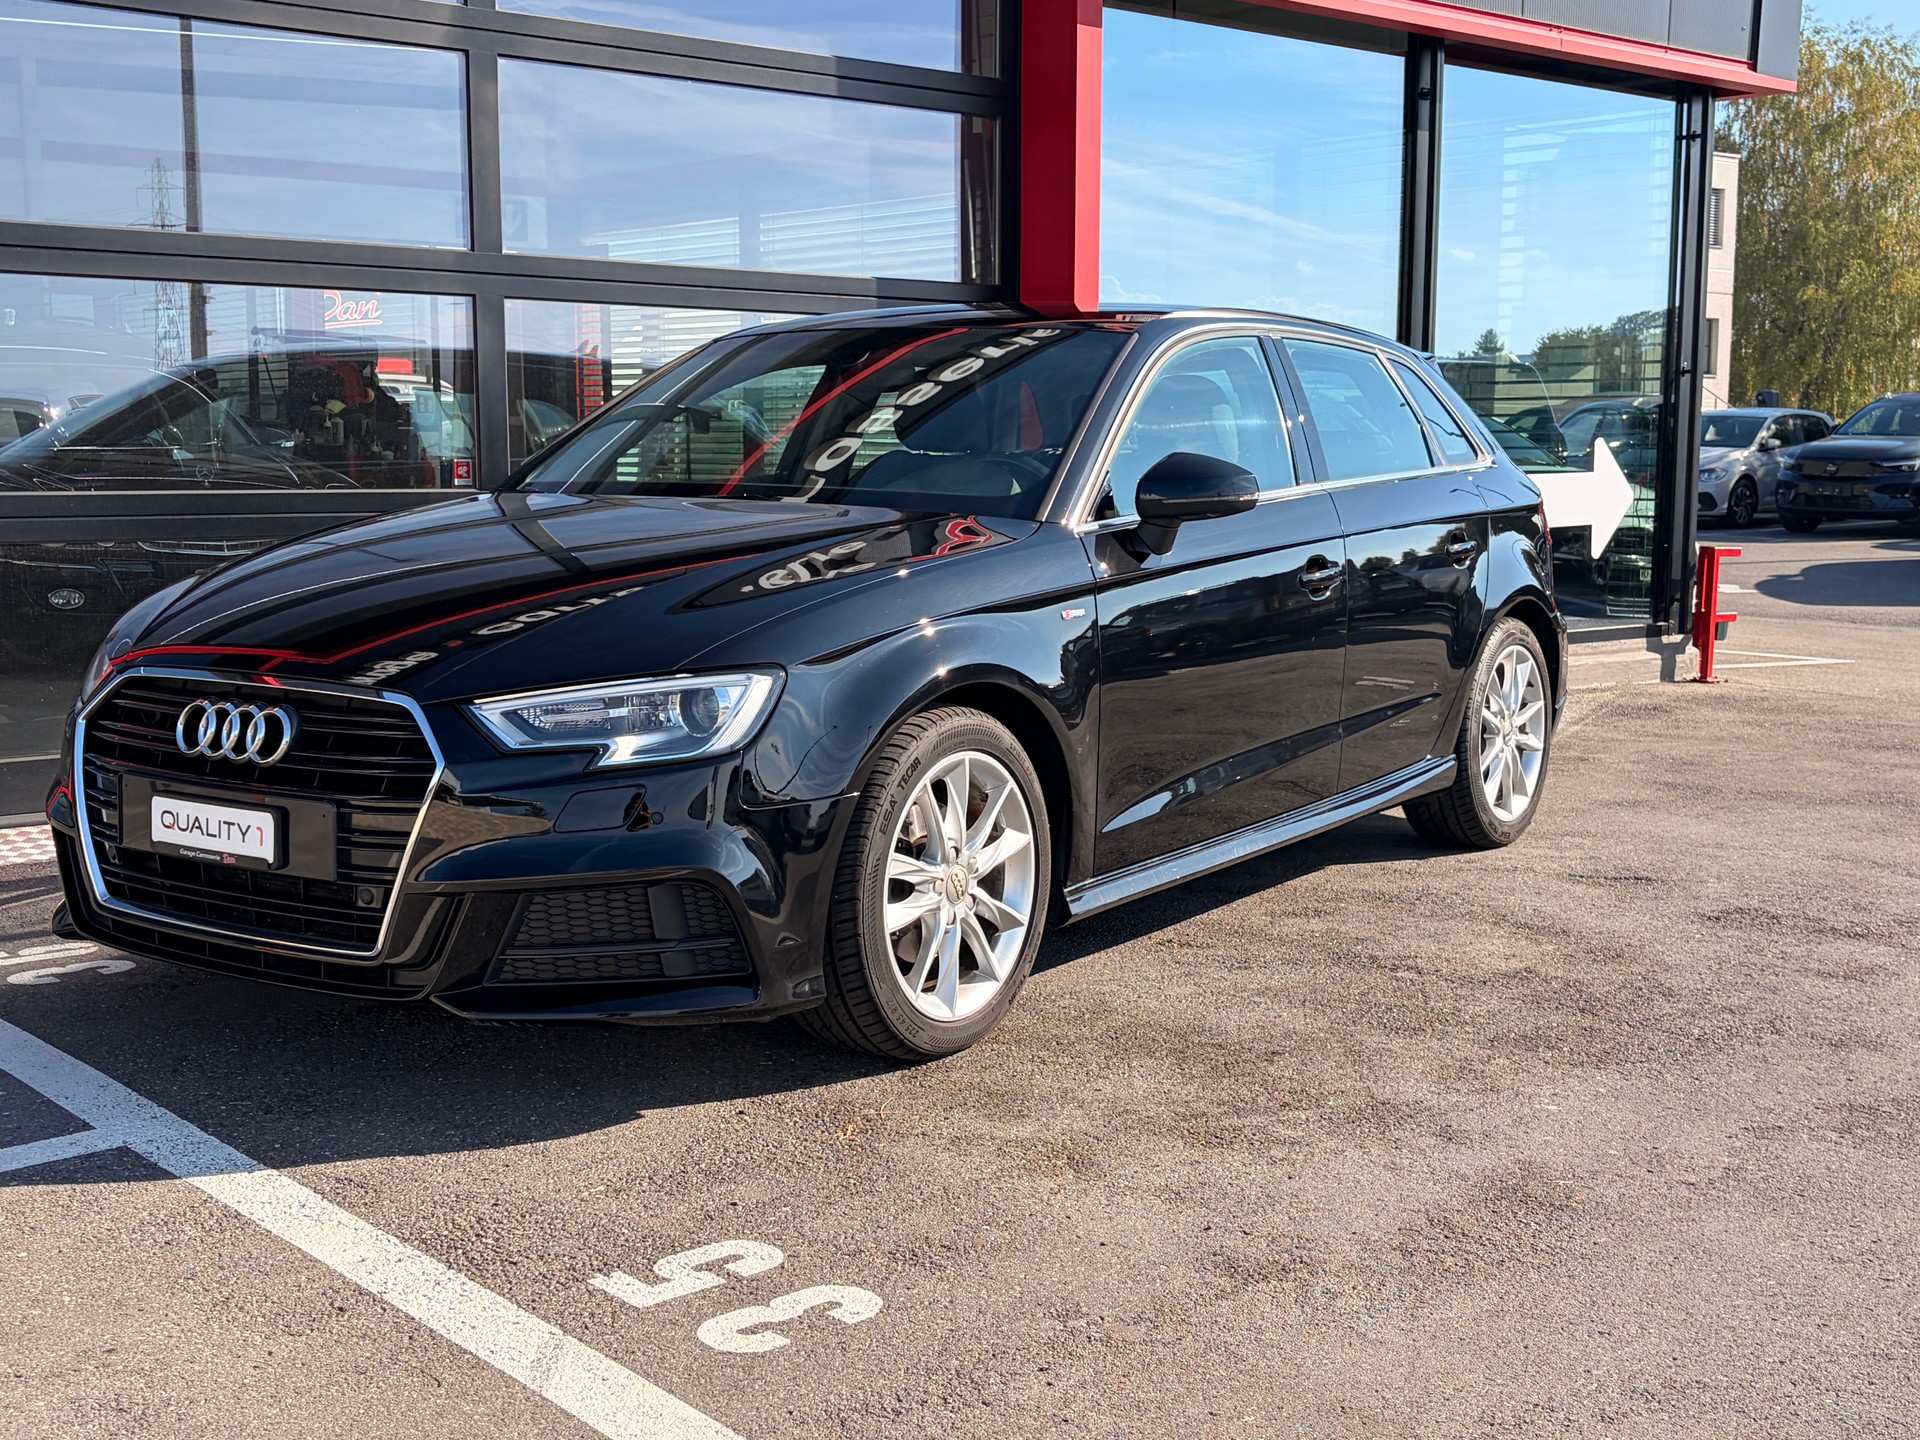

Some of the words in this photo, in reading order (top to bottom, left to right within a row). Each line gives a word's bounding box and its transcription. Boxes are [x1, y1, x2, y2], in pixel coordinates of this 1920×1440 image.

[896, 756, 922, 791] TECAR
[160, 809, 251, 843] QUALITY
[256, 826, 263, 847] 1
[896, 1014, 919, 1038] 225/45
